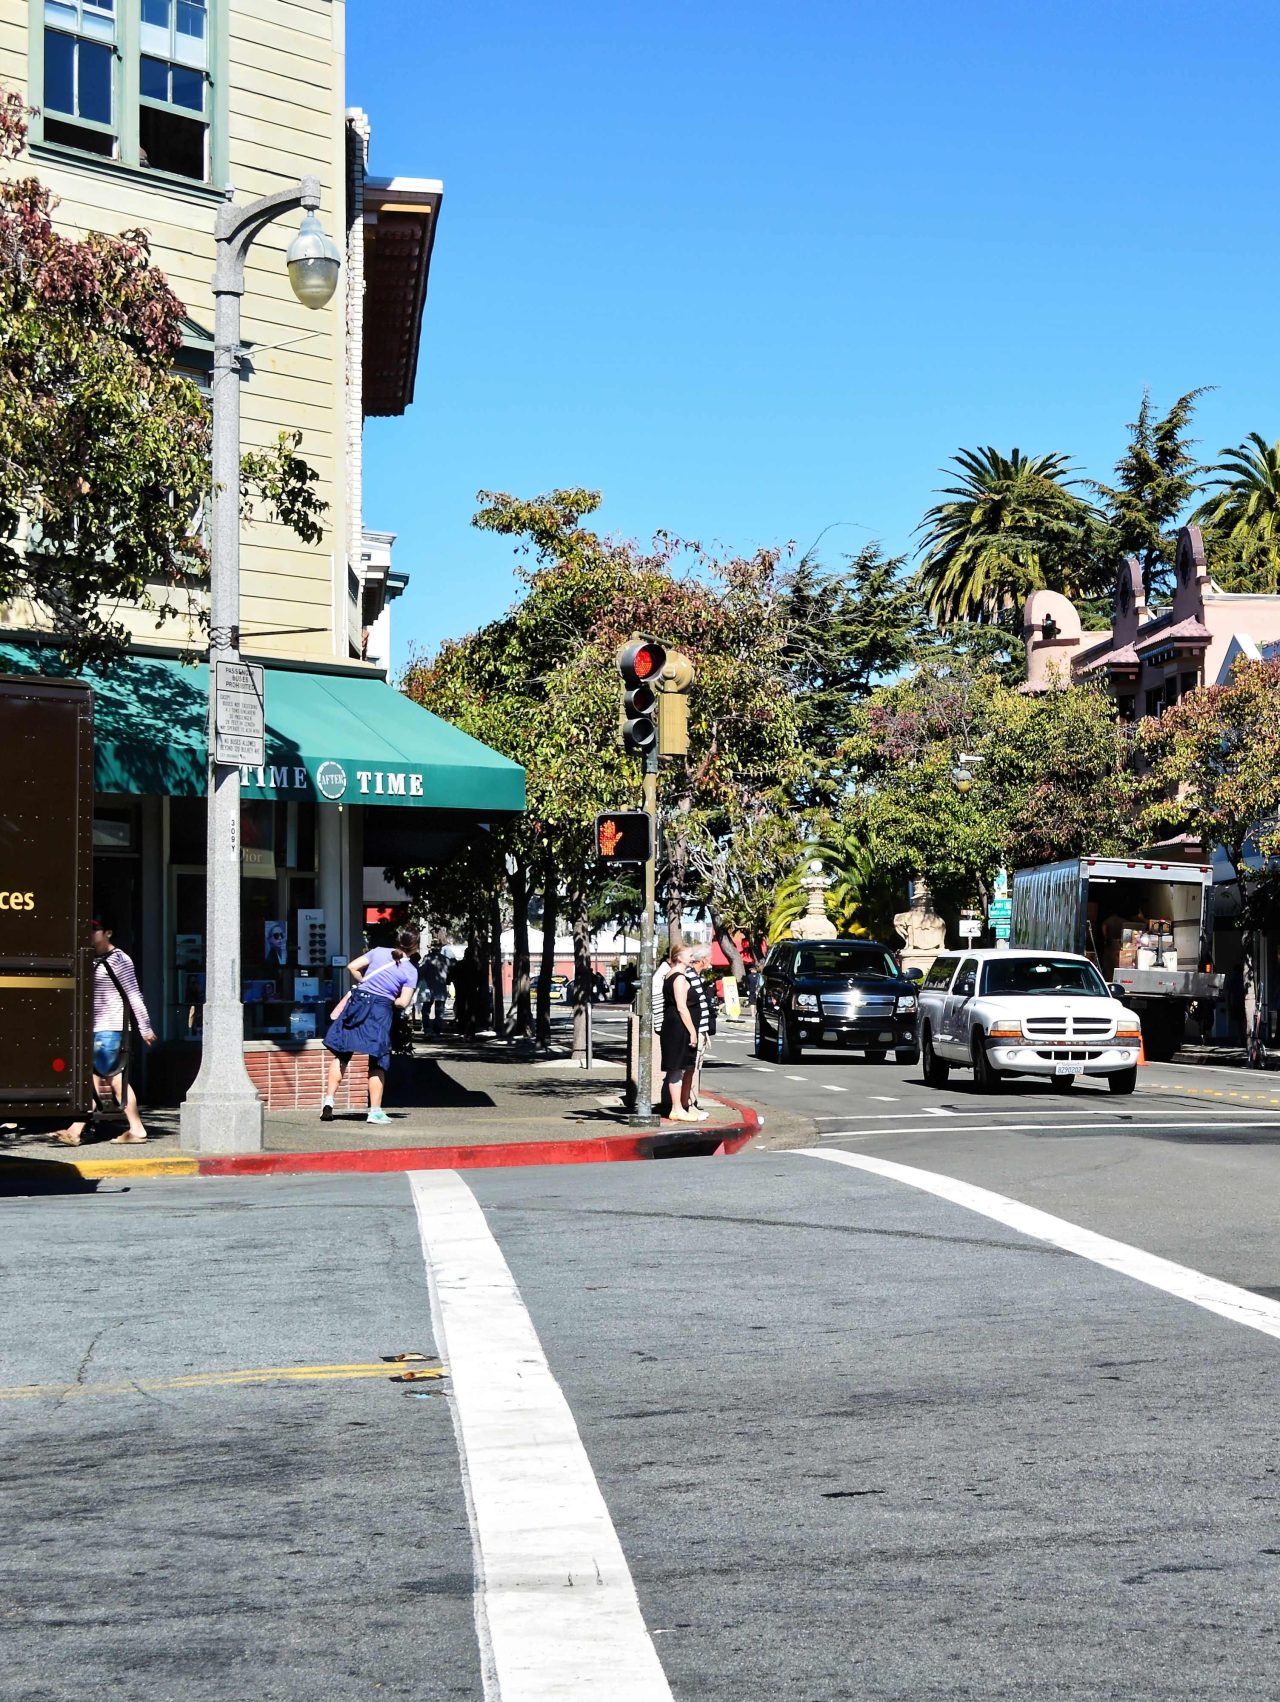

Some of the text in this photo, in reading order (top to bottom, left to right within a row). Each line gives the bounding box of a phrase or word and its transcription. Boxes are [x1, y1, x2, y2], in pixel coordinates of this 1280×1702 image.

[232, 675, 249, 683] BUSES
[239, 765, 424, 797] TIME AFTER TIME
